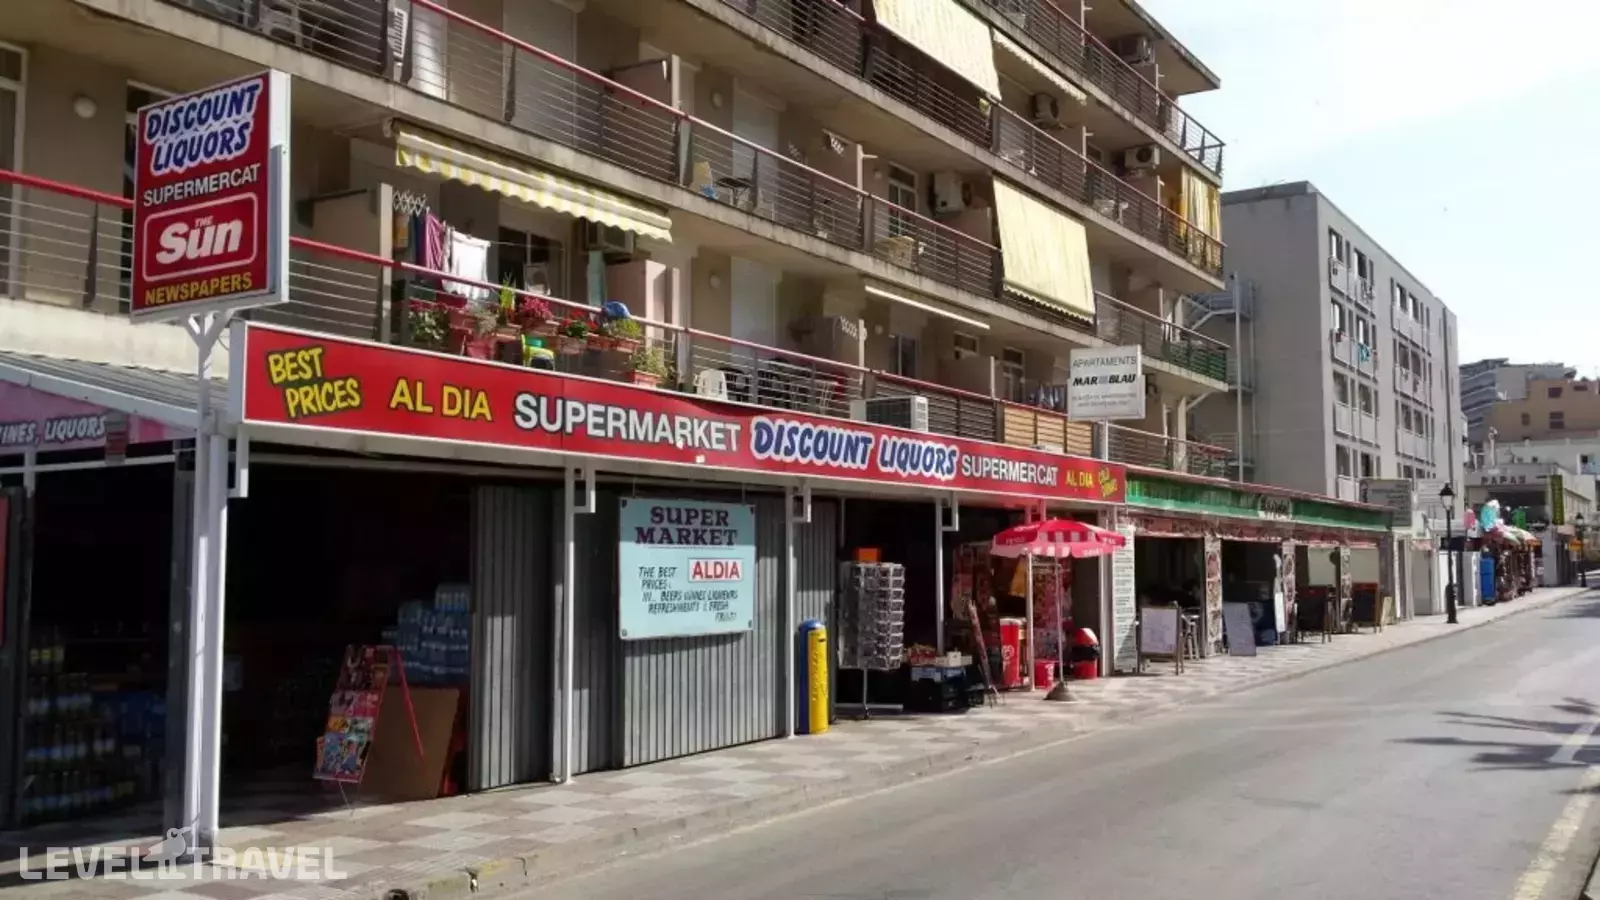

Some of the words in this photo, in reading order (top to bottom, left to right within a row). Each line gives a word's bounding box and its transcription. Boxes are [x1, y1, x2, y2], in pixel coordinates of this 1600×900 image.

[145, 82, 261, 140] DISCOUNT
[152, 119, 252, 173] LIQUORS
[143, 162, 261, 207] SUPERMERCAT
[195, 215, 214, 227] THE
[155, 218, 243, 265] Sun
[144, 271, 253, 306] NEWSPAPERS
[267, 347, 324, 385] BEST
[1072, 355, 1137, 368] APARTAMENTS
[1072, 376, 1099, 387] MAR
[1108, 373, 1137, 384] BLAU
[285, 376, 361, 418] PRICES
[0, 421, 40, 446] INES,
[44, 415, 107, 441] LIQUORS
[389, 377, 434, 414] AL
[442, 384, 492, 422] DIA
[513, 392, 742, 453] SUPERMARKET
[752, 416, 874, 470] DISCOUNT
[877, 434, 959, 481] LIQUORS
[961, 454, 1058, 487] SUPERMERCAT
[1065, 470, 1077, 487] AL
[650, 506, 730, 527] SUPER
[634, 526, 738, 546] MARKET
[638, 566, 655, 578] THE
[658, 566, 678, 578] BEST
[692, 561, 740, 579] ALDIA
[660, 590, 682, 602] BEERS
[709, 600, 729, 611] FRESH
